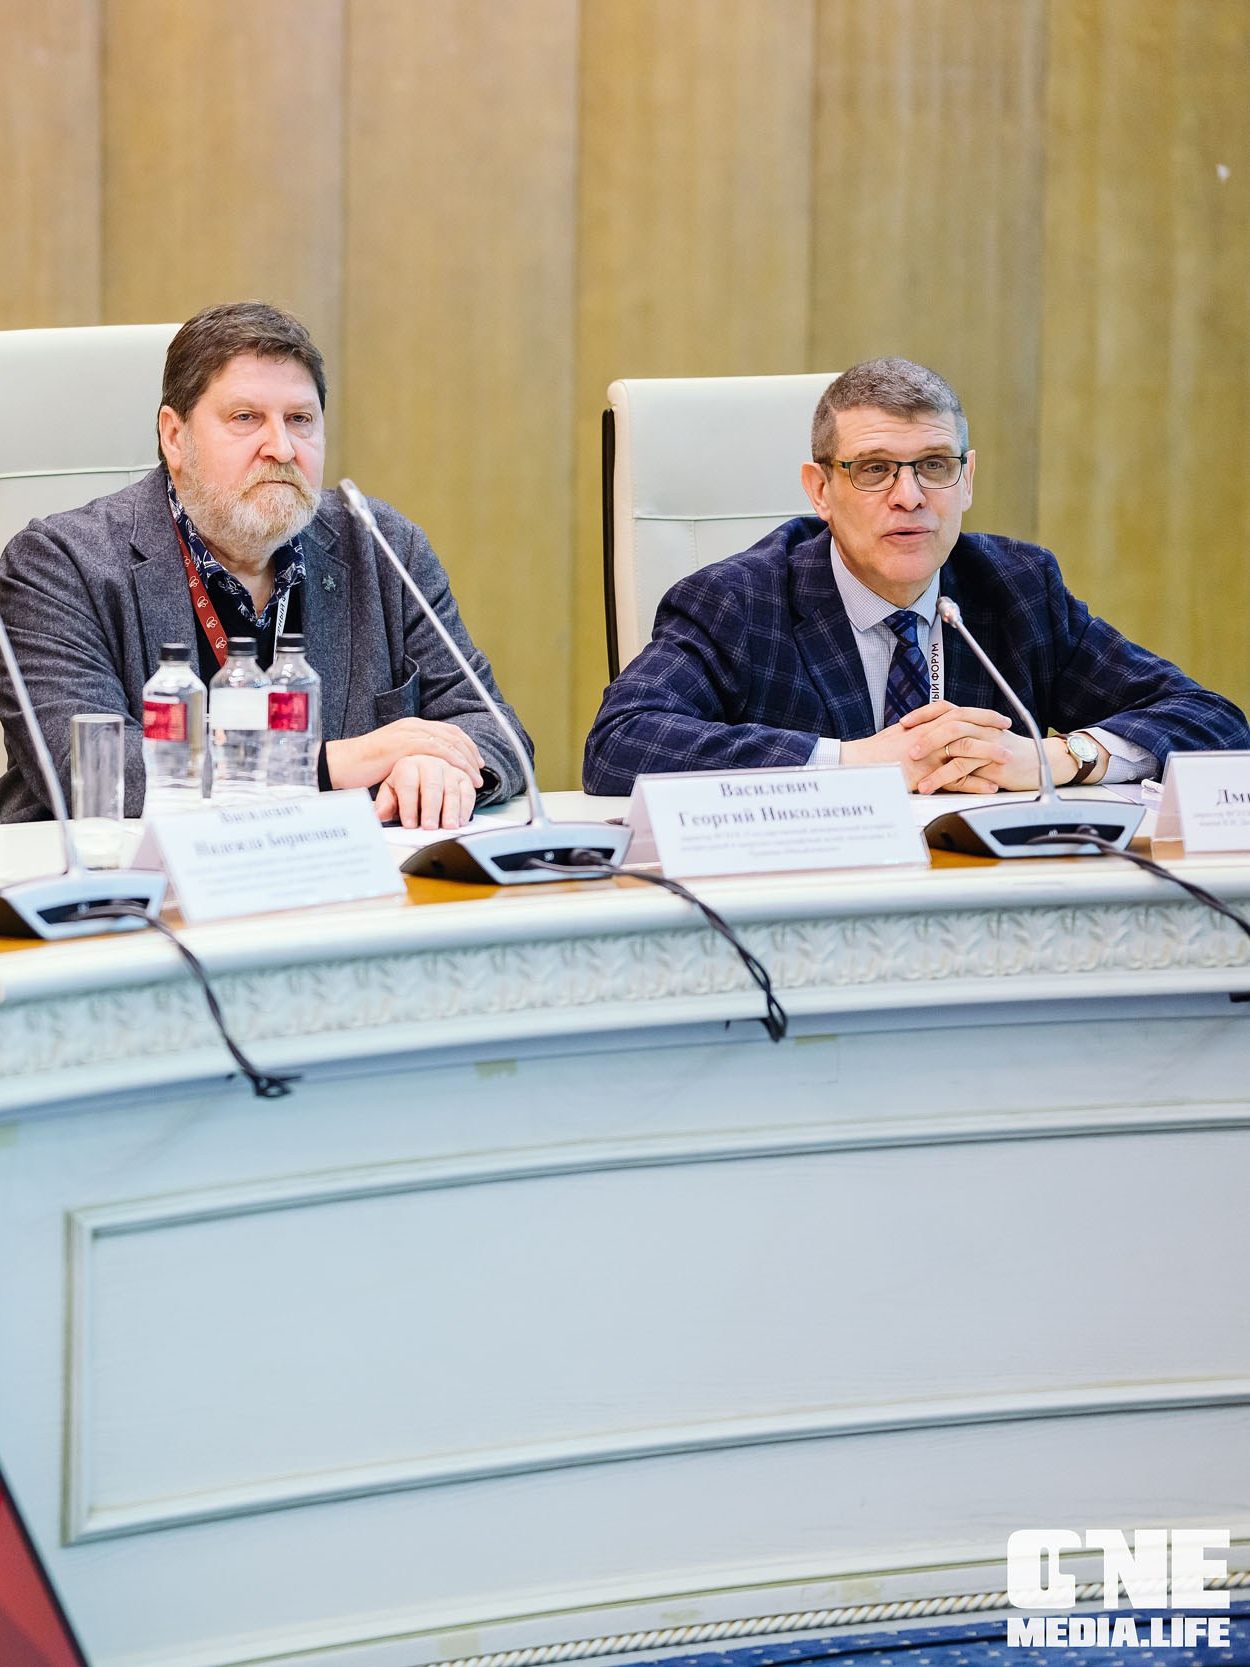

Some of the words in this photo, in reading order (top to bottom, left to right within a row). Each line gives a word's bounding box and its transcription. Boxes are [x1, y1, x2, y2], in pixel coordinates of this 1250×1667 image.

[931, 643, 940, 681] ФОРУМ
[720, 780, 820, 799] Василевич
[678, 807, 755, 829] Георгий
[760, 802, 875, 823] Николаевич
